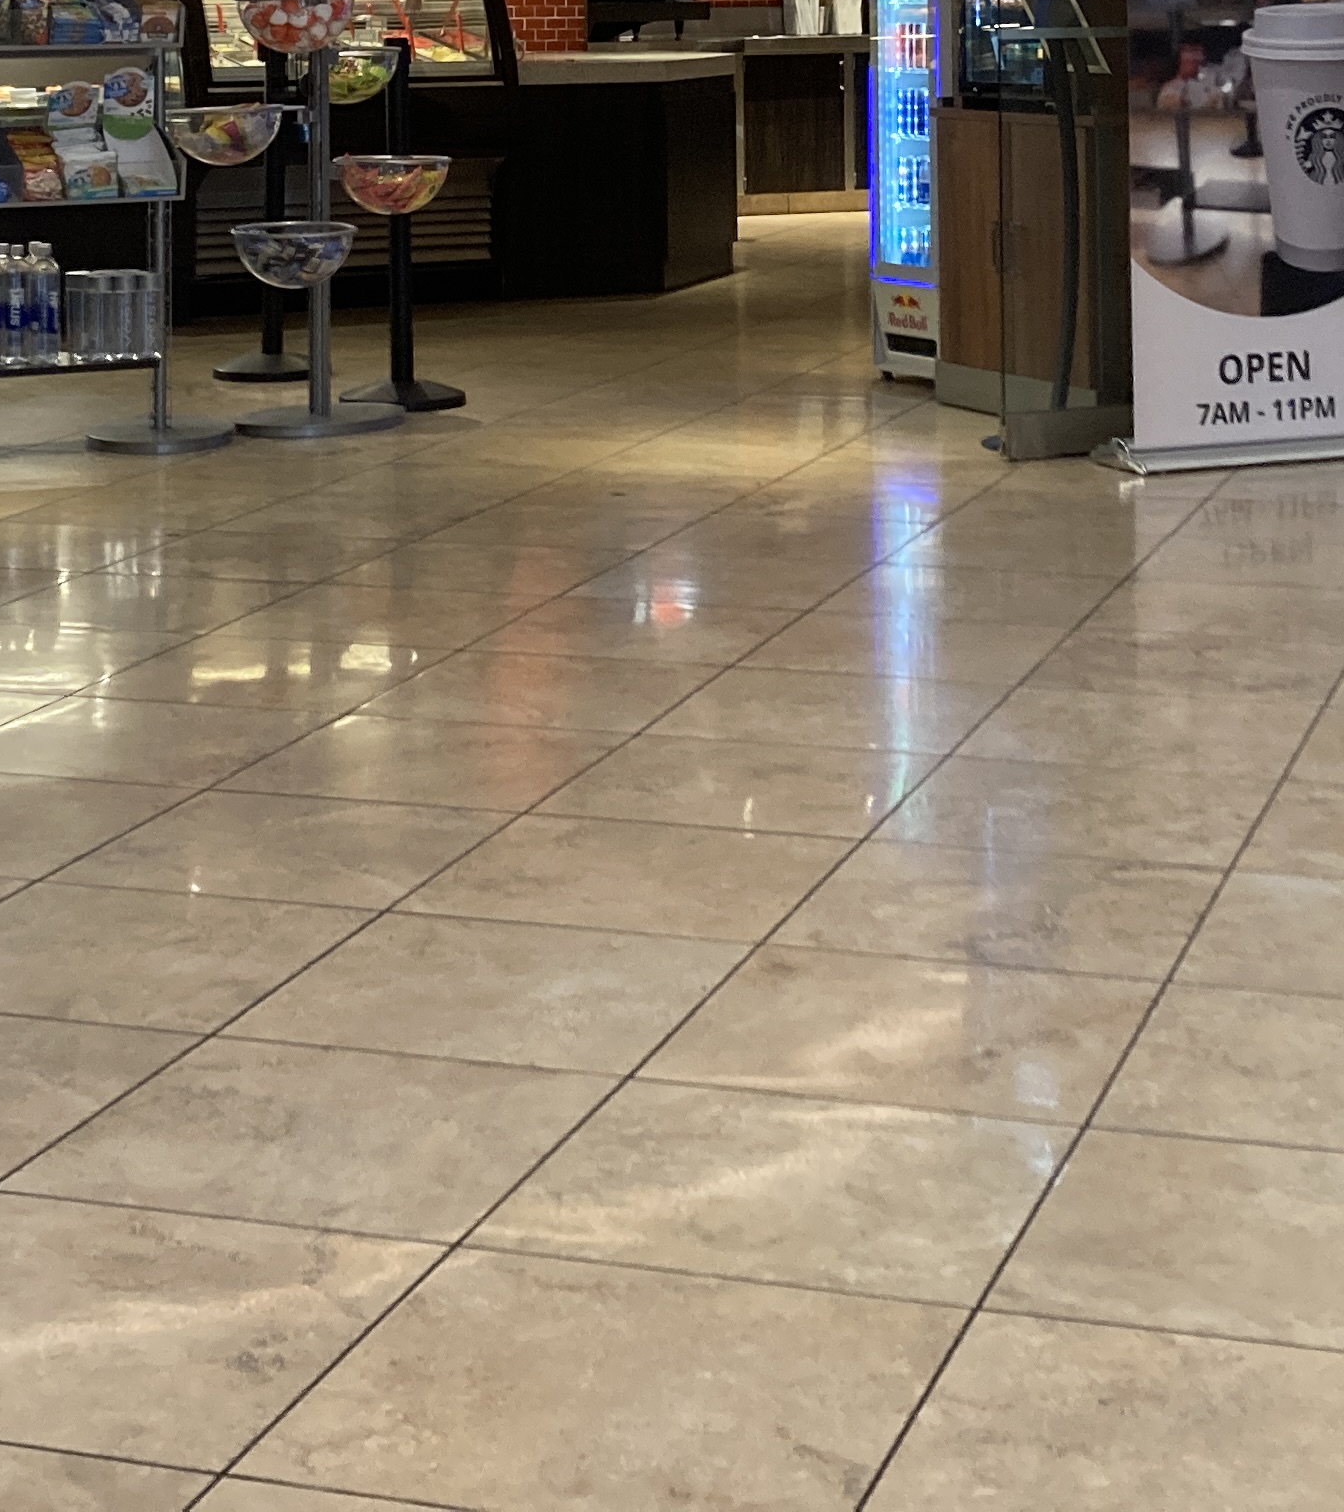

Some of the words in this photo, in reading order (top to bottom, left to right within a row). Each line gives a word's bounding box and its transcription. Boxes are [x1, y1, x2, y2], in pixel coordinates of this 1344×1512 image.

[1218, 350, 1311, 385] OPEN
[1196, 401, 1250, 427] 7AM
[1272, 396, 1336, 422] 11PM
